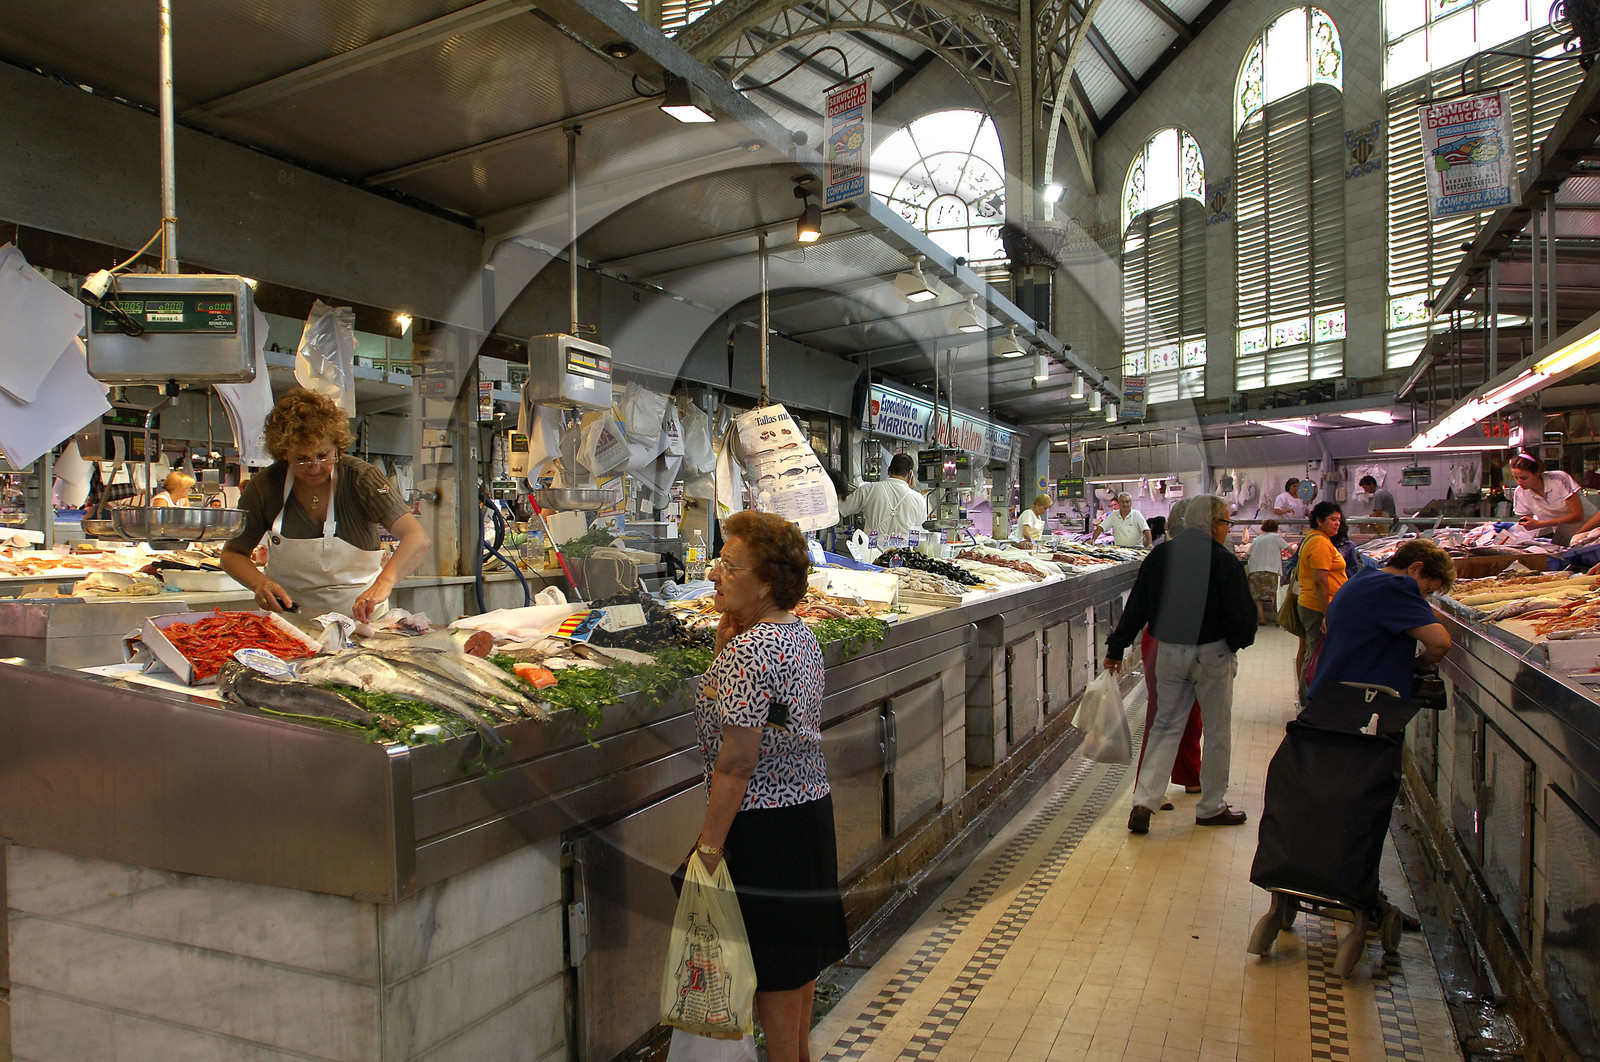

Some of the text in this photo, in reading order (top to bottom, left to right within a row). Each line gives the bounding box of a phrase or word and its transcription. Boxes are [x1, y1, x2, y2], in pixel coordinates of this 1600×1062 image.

[829, 85, 866, 107] SERVICIO A
[829, 94, 866, 117] DOMICILIO
[1427, 97, 1499, 119] SERVICIO A
[1428, 107, 1501, 128] DOMICILIO
[278, 169, 296, 187] 84
[1446, 181, 1472, 191] MERCADO
[1437, 193, 1483, 208] COMPRAR
[1456, 203, 1468, 211] te
[880, 393, 912, 418] Especialidad
[911, 407, 918, 420] en
[754, 414, 777, 426] Tallas
[877, 413, 923, 439] MARISCOS
[960, 420, 982, 453] Valero
